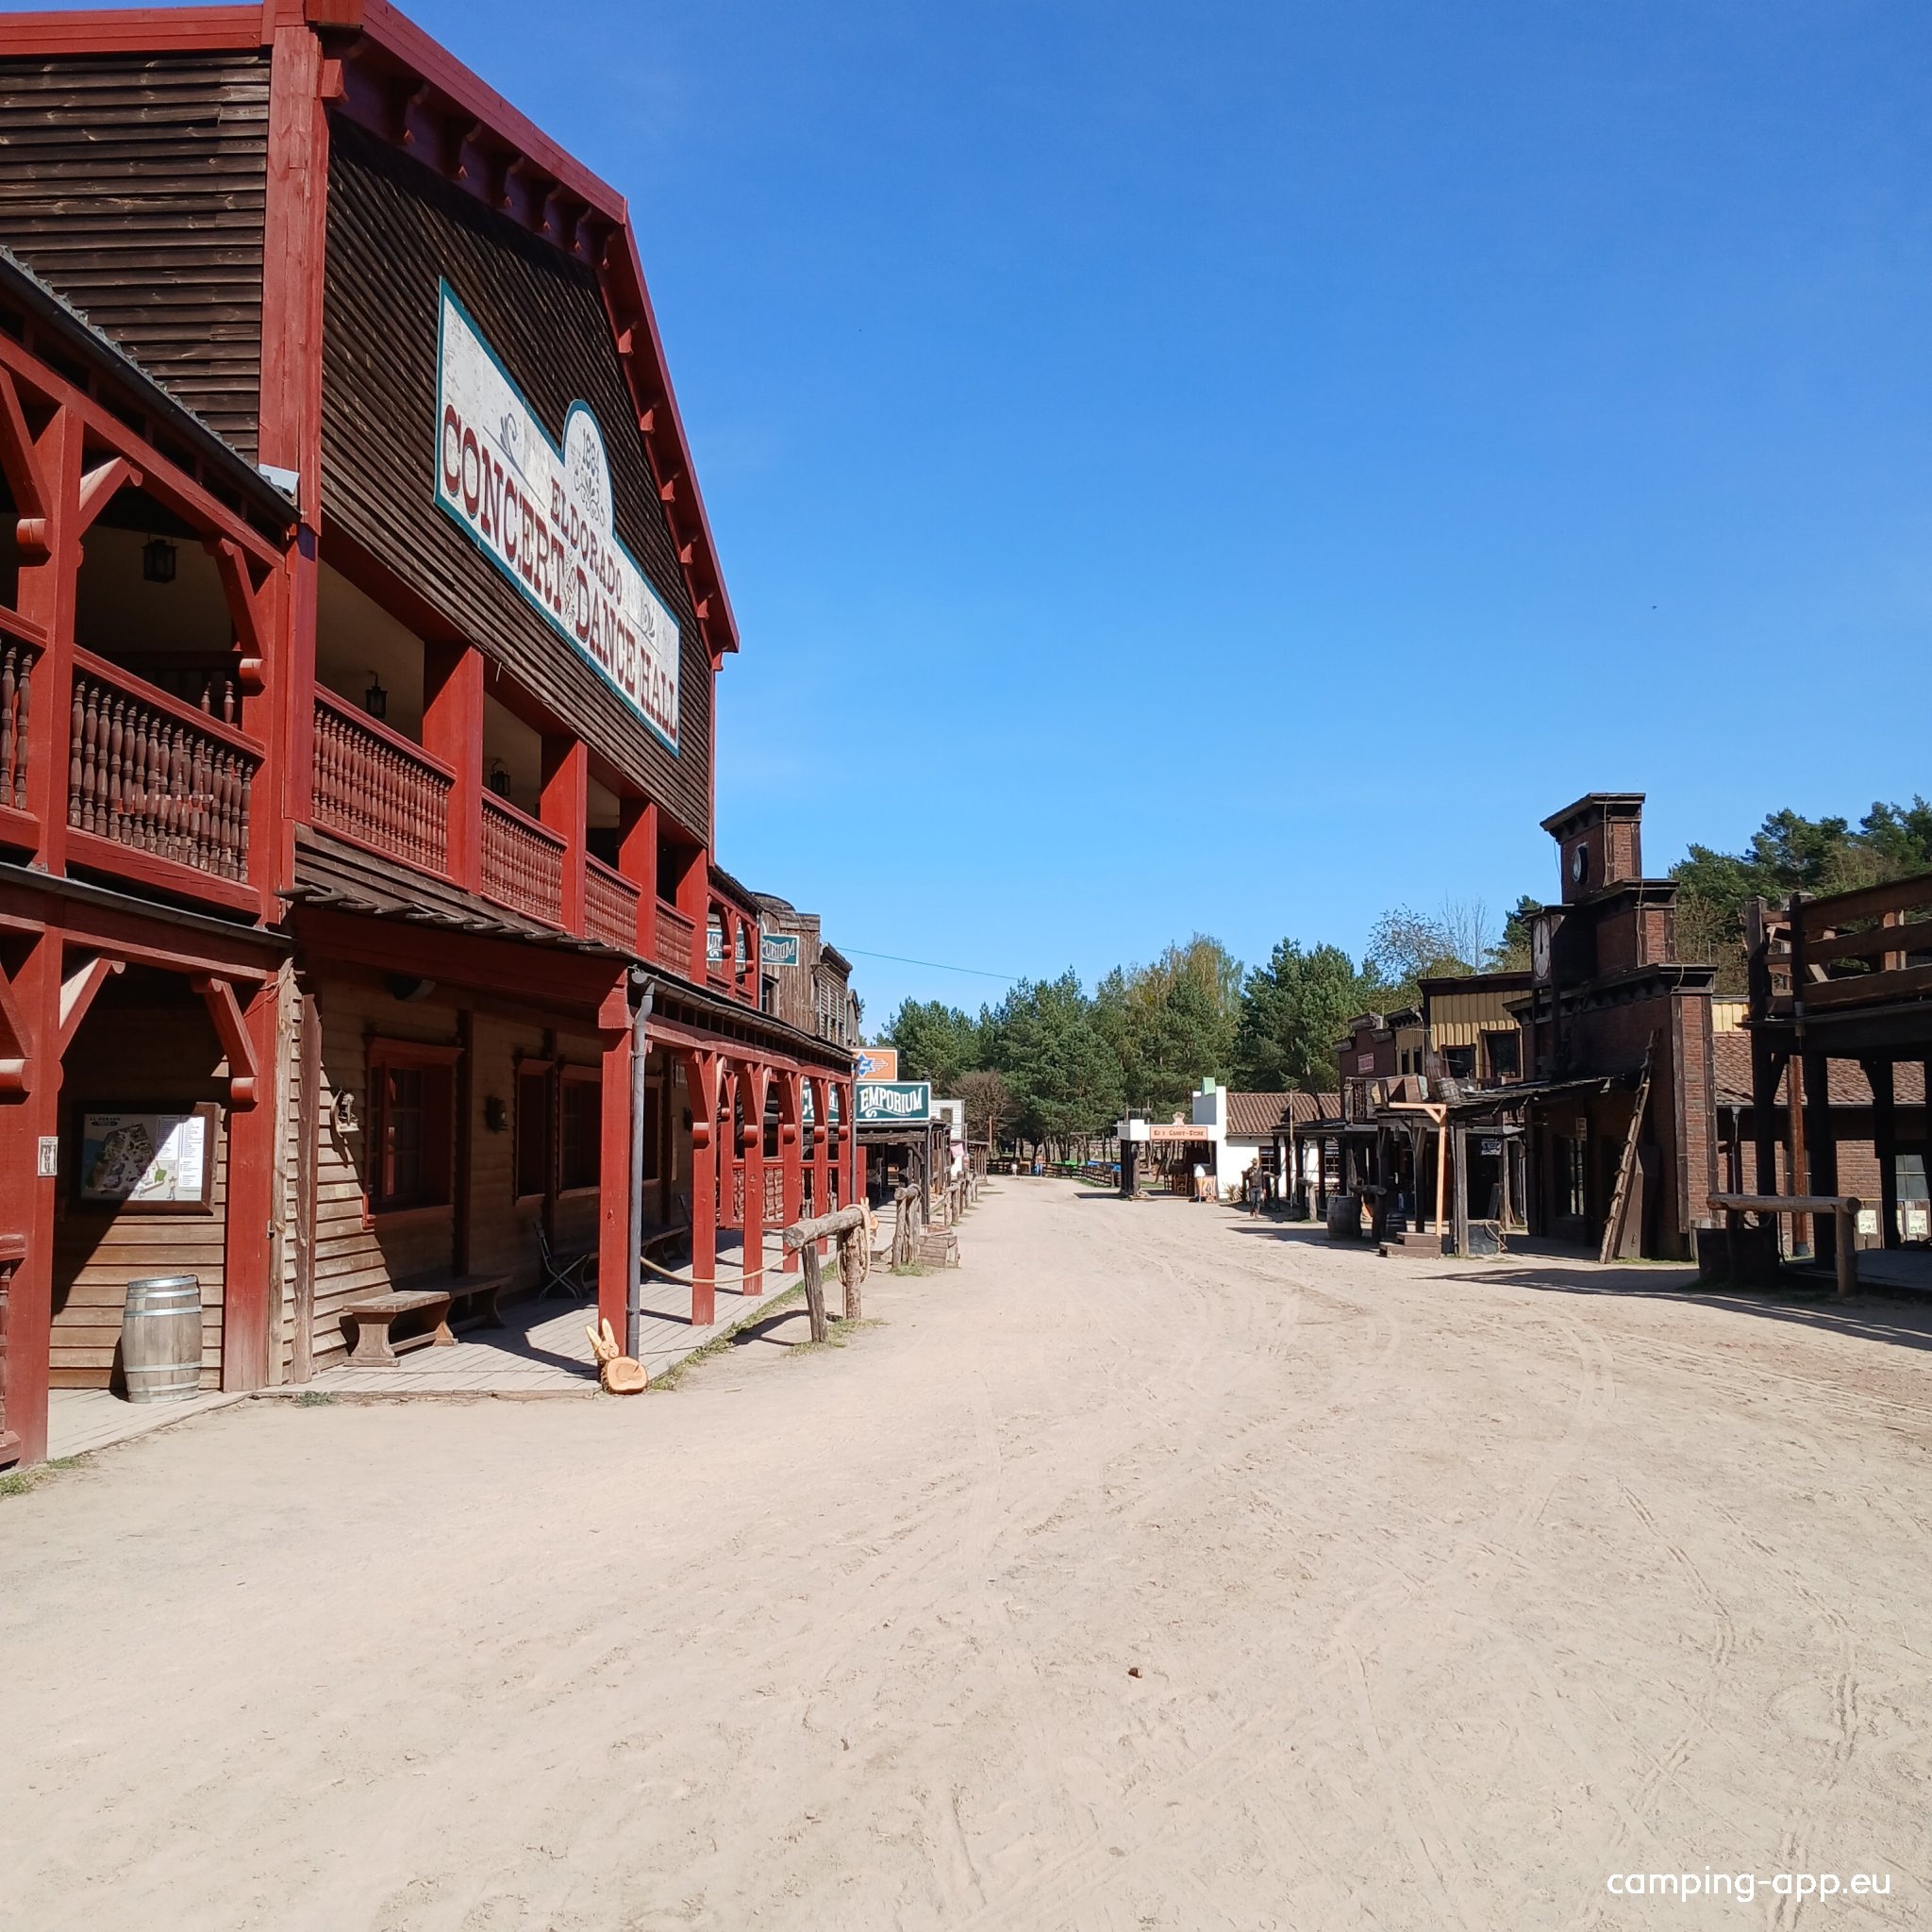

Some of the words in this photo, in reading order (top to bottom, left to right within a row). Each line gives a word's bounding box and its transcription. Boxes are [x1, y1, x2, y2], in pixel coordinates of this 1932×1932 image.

[443, 404, 564, 616] CONCERT
[575, 564, 636, 698] DANCE
[640, 645, 677, 742] HALL
[550, 475, 623, 605] ELDORADO
[859, 1086, 923, 1114] EMPORIUM
